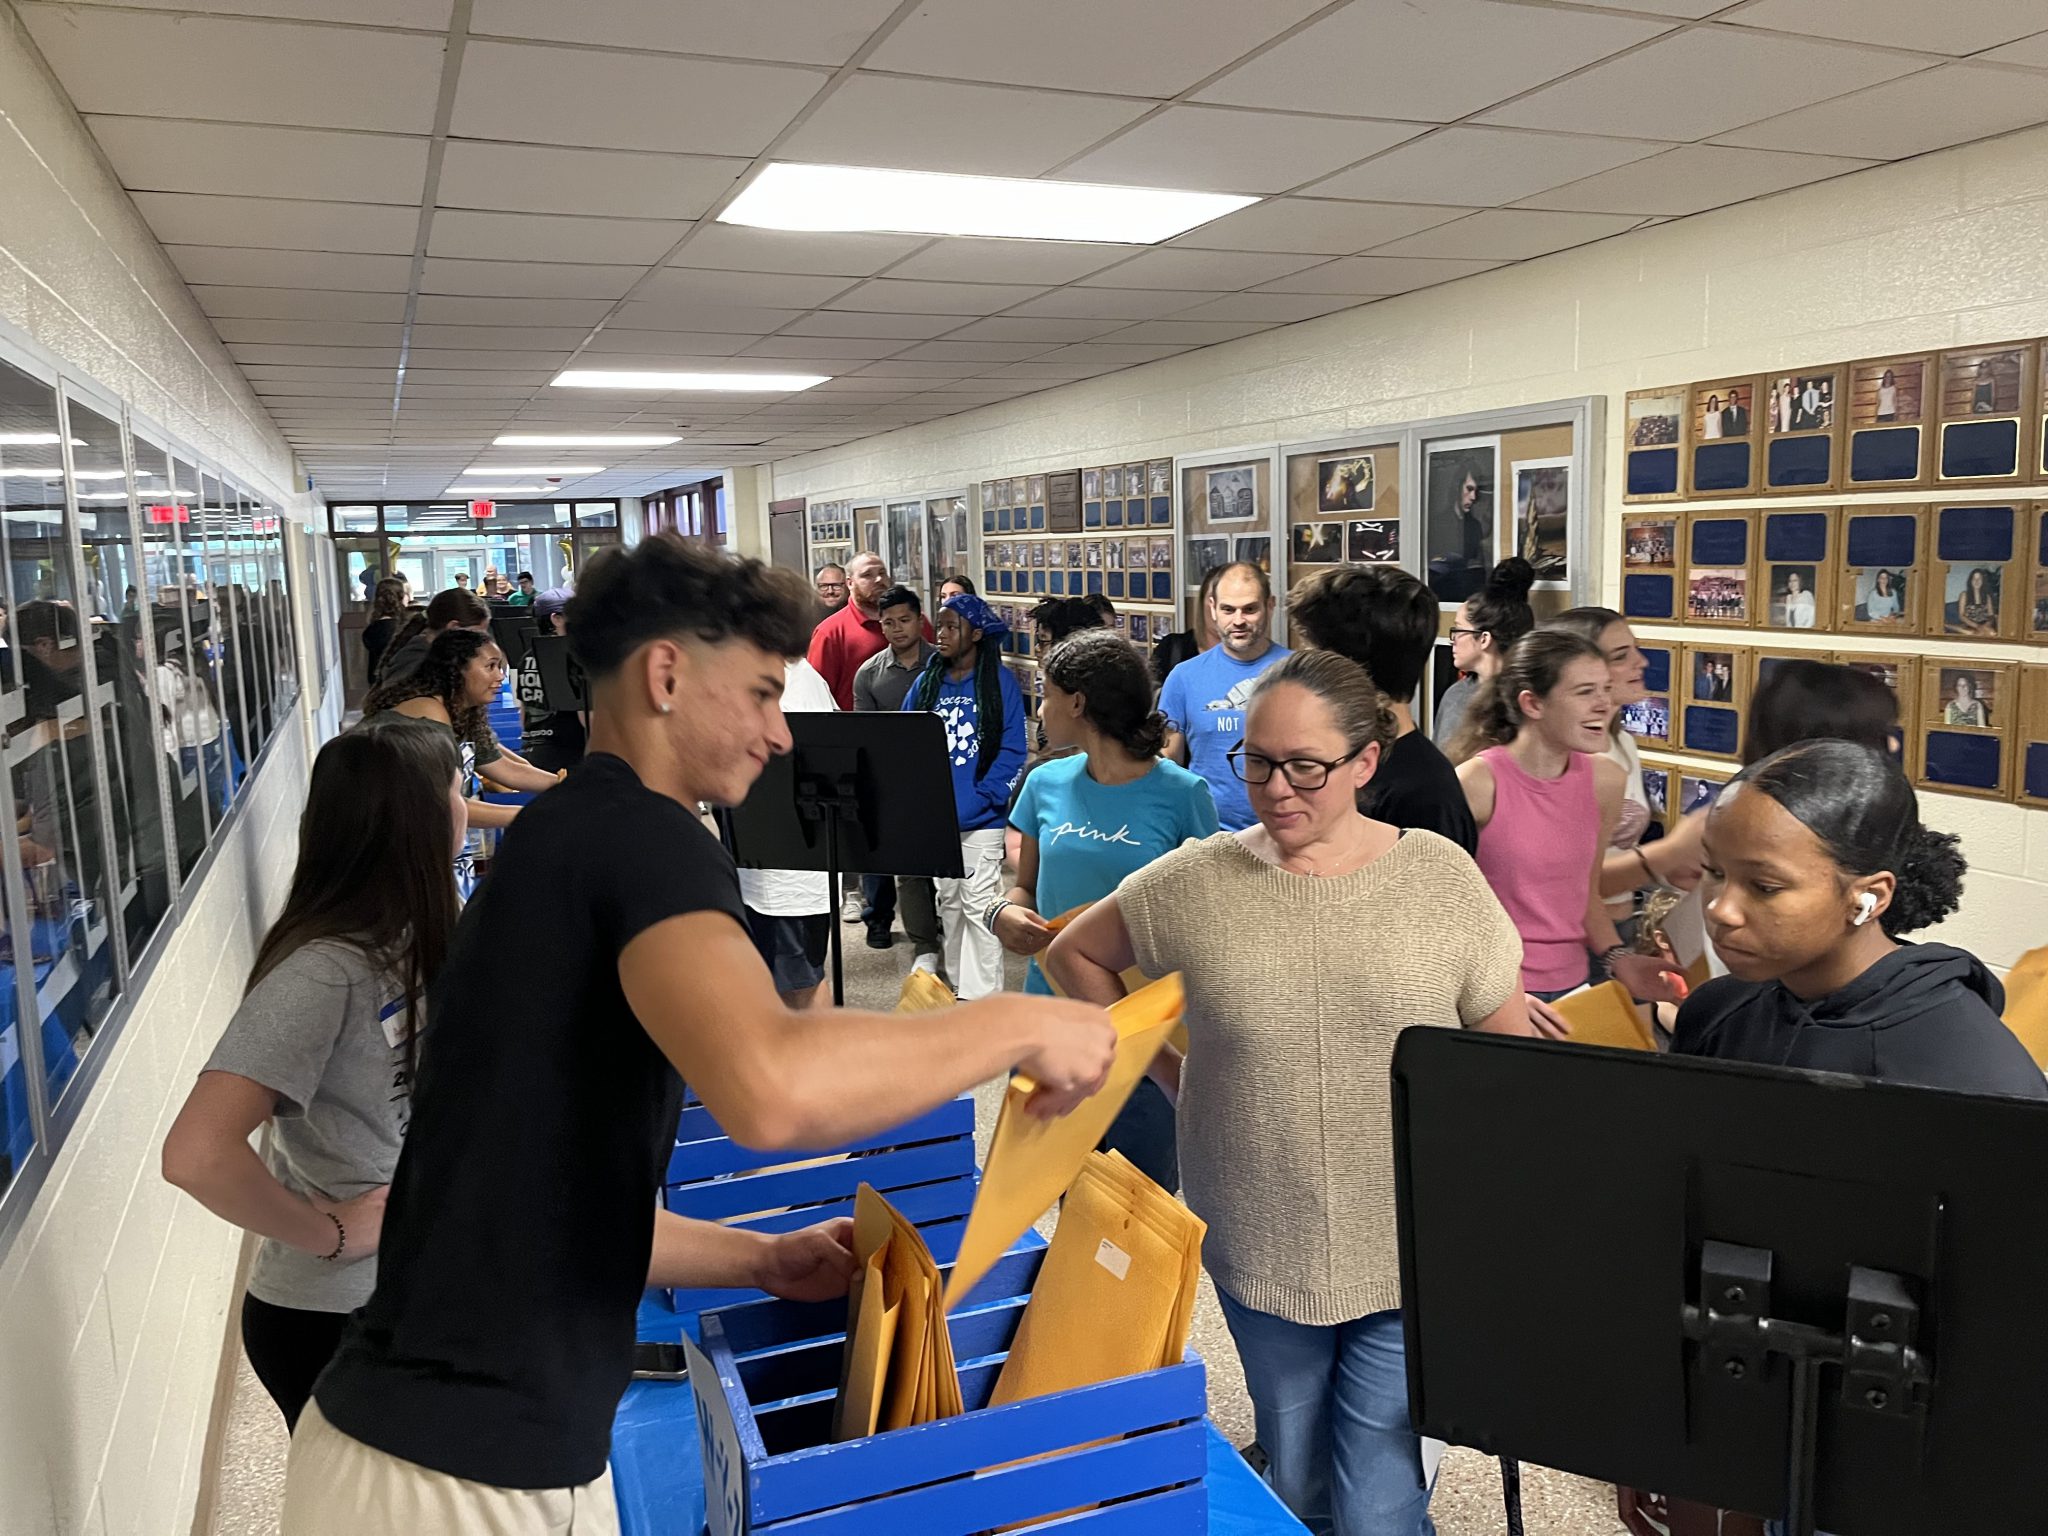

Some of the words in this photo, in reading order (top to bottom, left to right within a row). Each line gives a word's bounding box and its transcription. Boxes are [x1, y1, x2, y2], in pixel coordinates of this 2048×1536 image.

[473, 503, 492, 517] EXIT
[1217, 716, 1239, 732] NOT
[1049, 822, 1141, 846] pink
